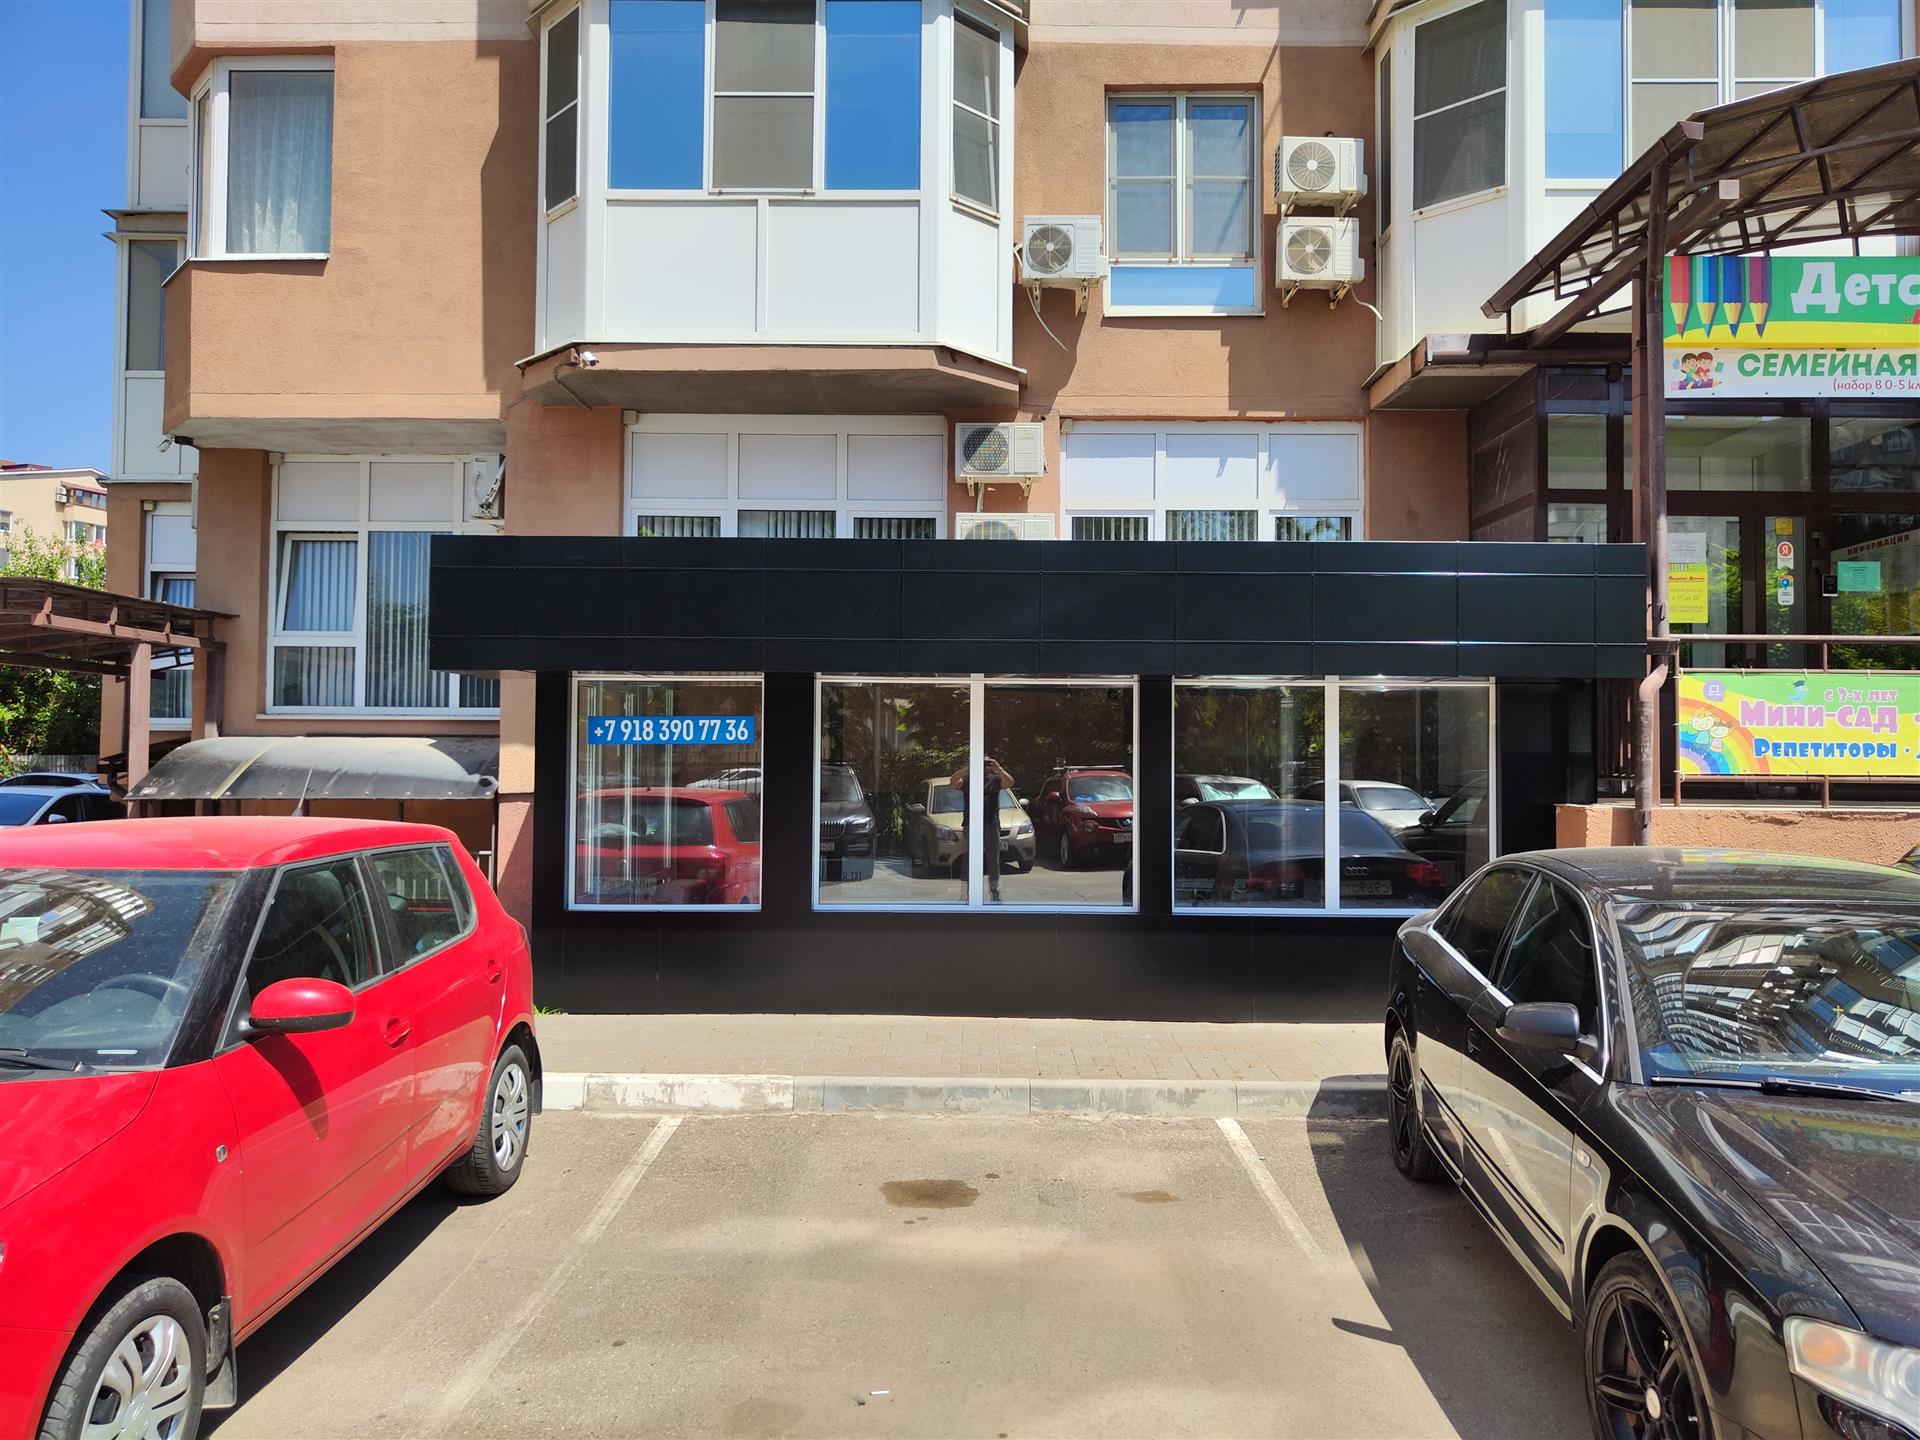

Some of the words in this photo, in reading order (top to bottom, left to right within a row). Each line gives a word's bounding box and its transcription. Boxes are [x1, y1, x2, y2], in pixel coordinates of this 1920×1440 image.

[1737, 348, 1917, 377] СЕМЕЙНАЯ
[1833, 378, 1873, 392] (набор
[1781, 545, 1789, 555] Я
[1847, 533, 1910, 556] ИНФОРМАЦИЯ
[594, 719, 616, 741] +7
[620, 719, 654, 741] 918
[658, 719, 694, 741] 390
[698, 719, 721, 741] 77
[725, 719, 749, 741] 36
